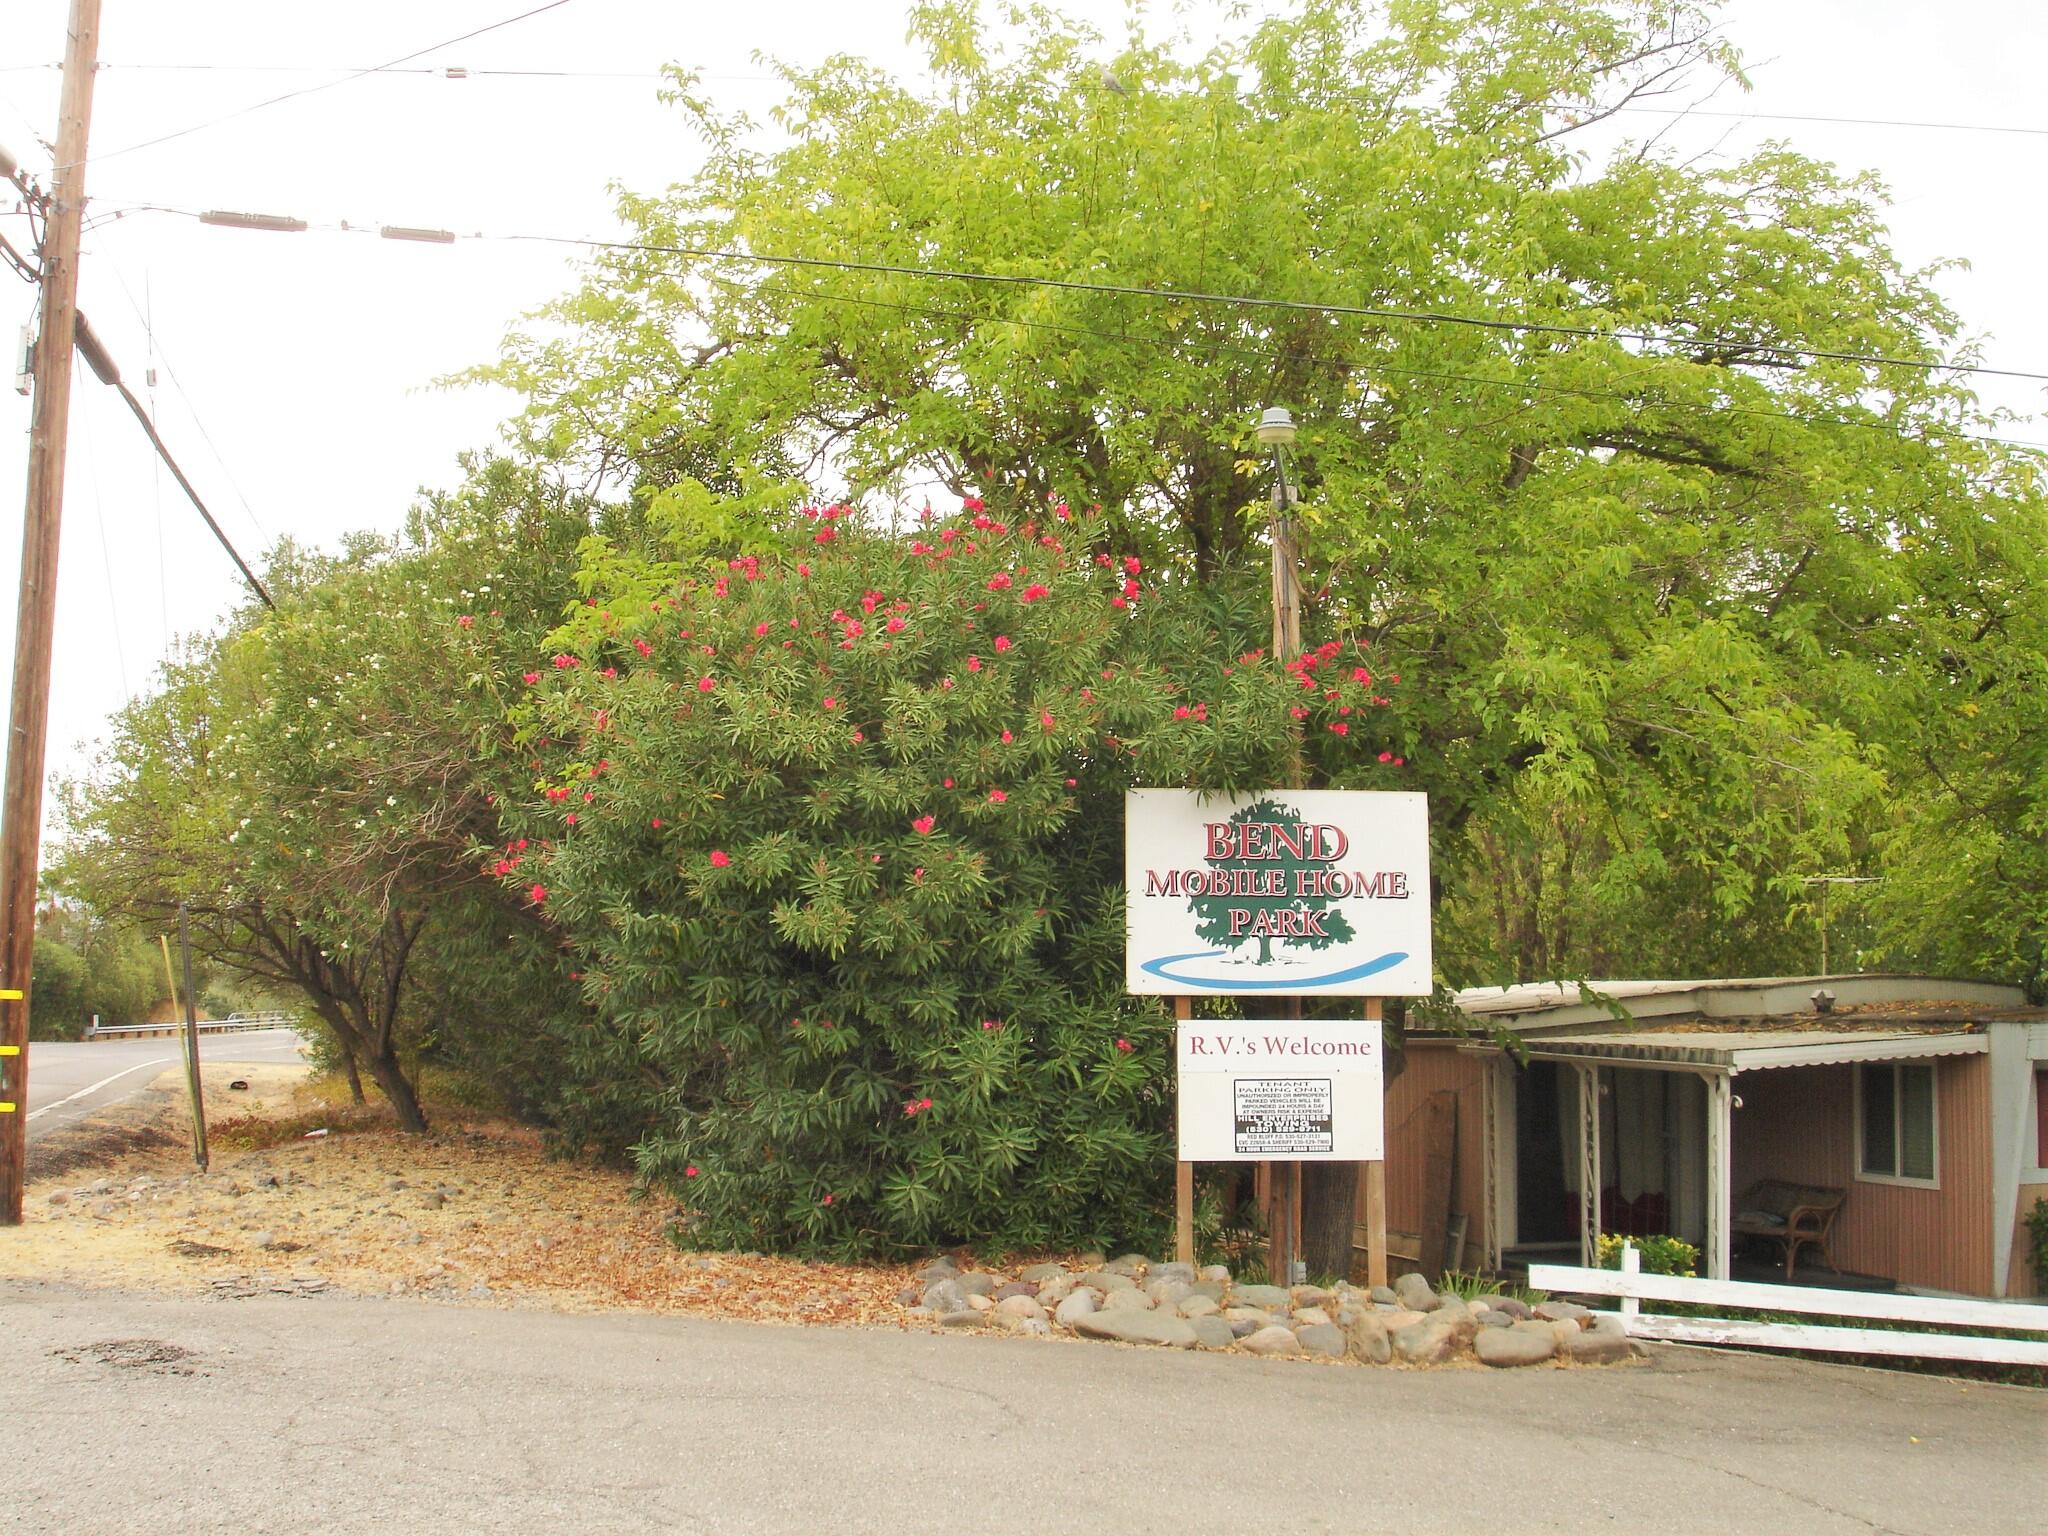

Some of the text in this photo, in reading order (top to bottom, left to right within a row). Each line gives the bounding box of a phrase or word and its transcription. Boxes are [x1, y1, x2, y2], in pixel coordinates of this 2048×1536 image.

[1204, 822, 1348, 862] BEND
[1145, 869, 1409, 899] MOBILE HOME
[1228, 908, 1328, 938] PARK
[1190, 1036, 1371, 1056] R.V.'s Welcome
